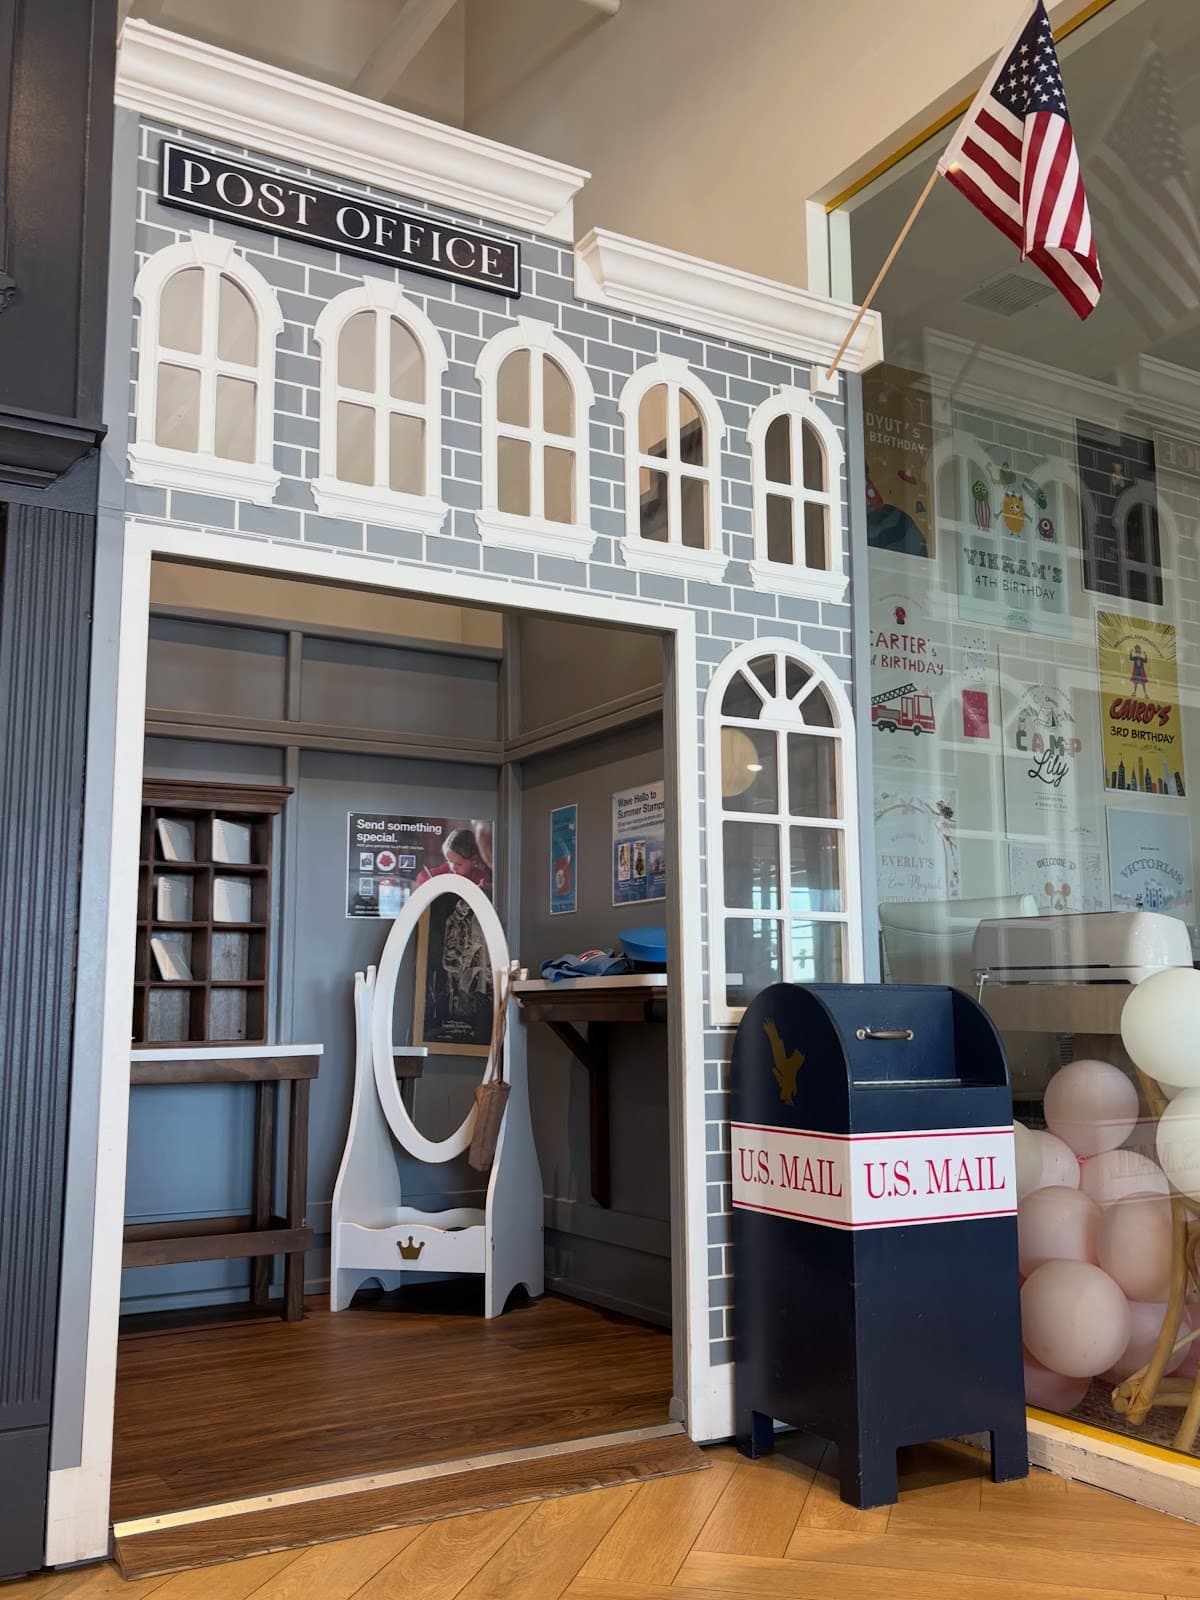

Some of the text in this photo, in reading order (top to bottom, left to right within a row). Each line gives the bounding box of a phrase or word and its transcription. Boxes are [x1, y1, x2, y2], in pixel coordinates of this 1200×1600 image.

[182, 159, 504, 279] POST OFFICE
[869, 431, 925, 455] BIRTHDAY
[975, 575, 1055, 600] 4TH BIRTHDAY
[1109, 697, 1172, 727] CAIRO'S
[1110, 725, 1175, 744] 3RD BIRTHDAY
[1028, 749, 1069, 788] Lily
[634, 793, 649, 803] Hello
[650, 791, 657, 799] to
[618, 808, 642, 819] Summer
[356, 819, 442, 835] Send something
[356, 832, 398, 843] special.
[881, 855, 935, 869] EVERLY'S
[739, 1148, 842, 1197] U.S. MAIL
[864, 1156, 1006, 1199] U.S. MAIL
